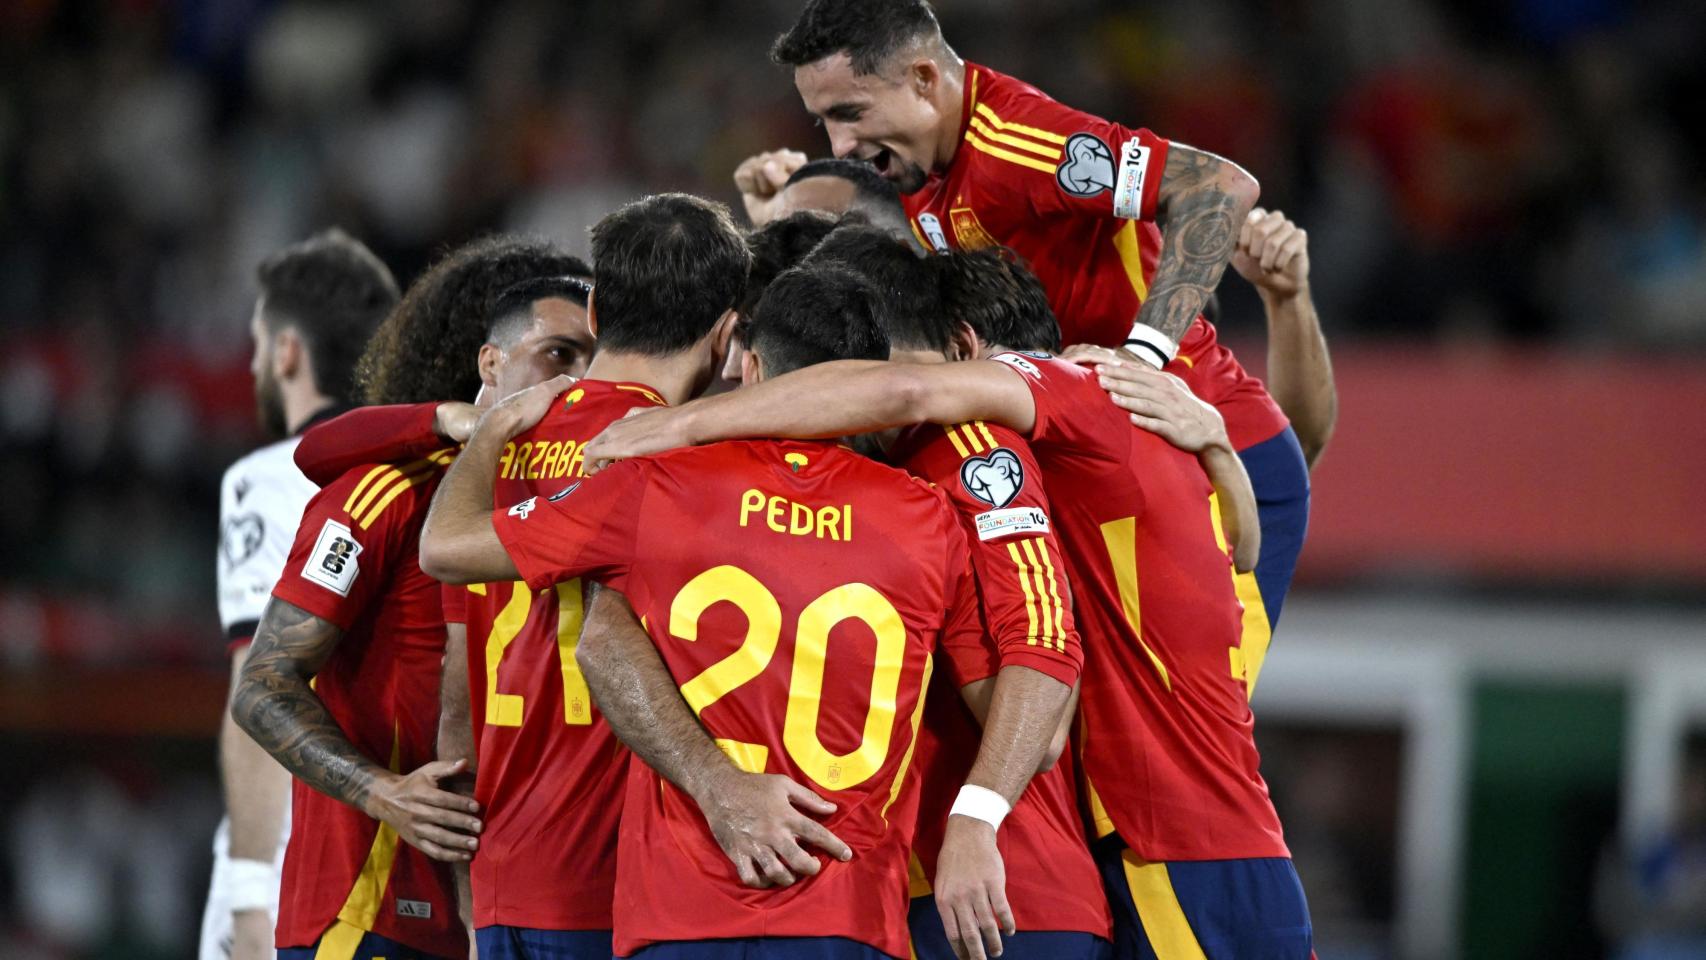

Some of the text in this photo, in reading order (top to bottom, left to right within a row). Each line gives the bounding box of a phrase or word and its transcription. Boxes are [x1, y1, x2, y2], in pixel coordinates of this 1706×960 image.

[500, 440, 591, 480] ARZABA
[739, 488, 852, 542] PEDRI
[466, 577, 593, 728] 21
[669, 564, 907, 791] 20
